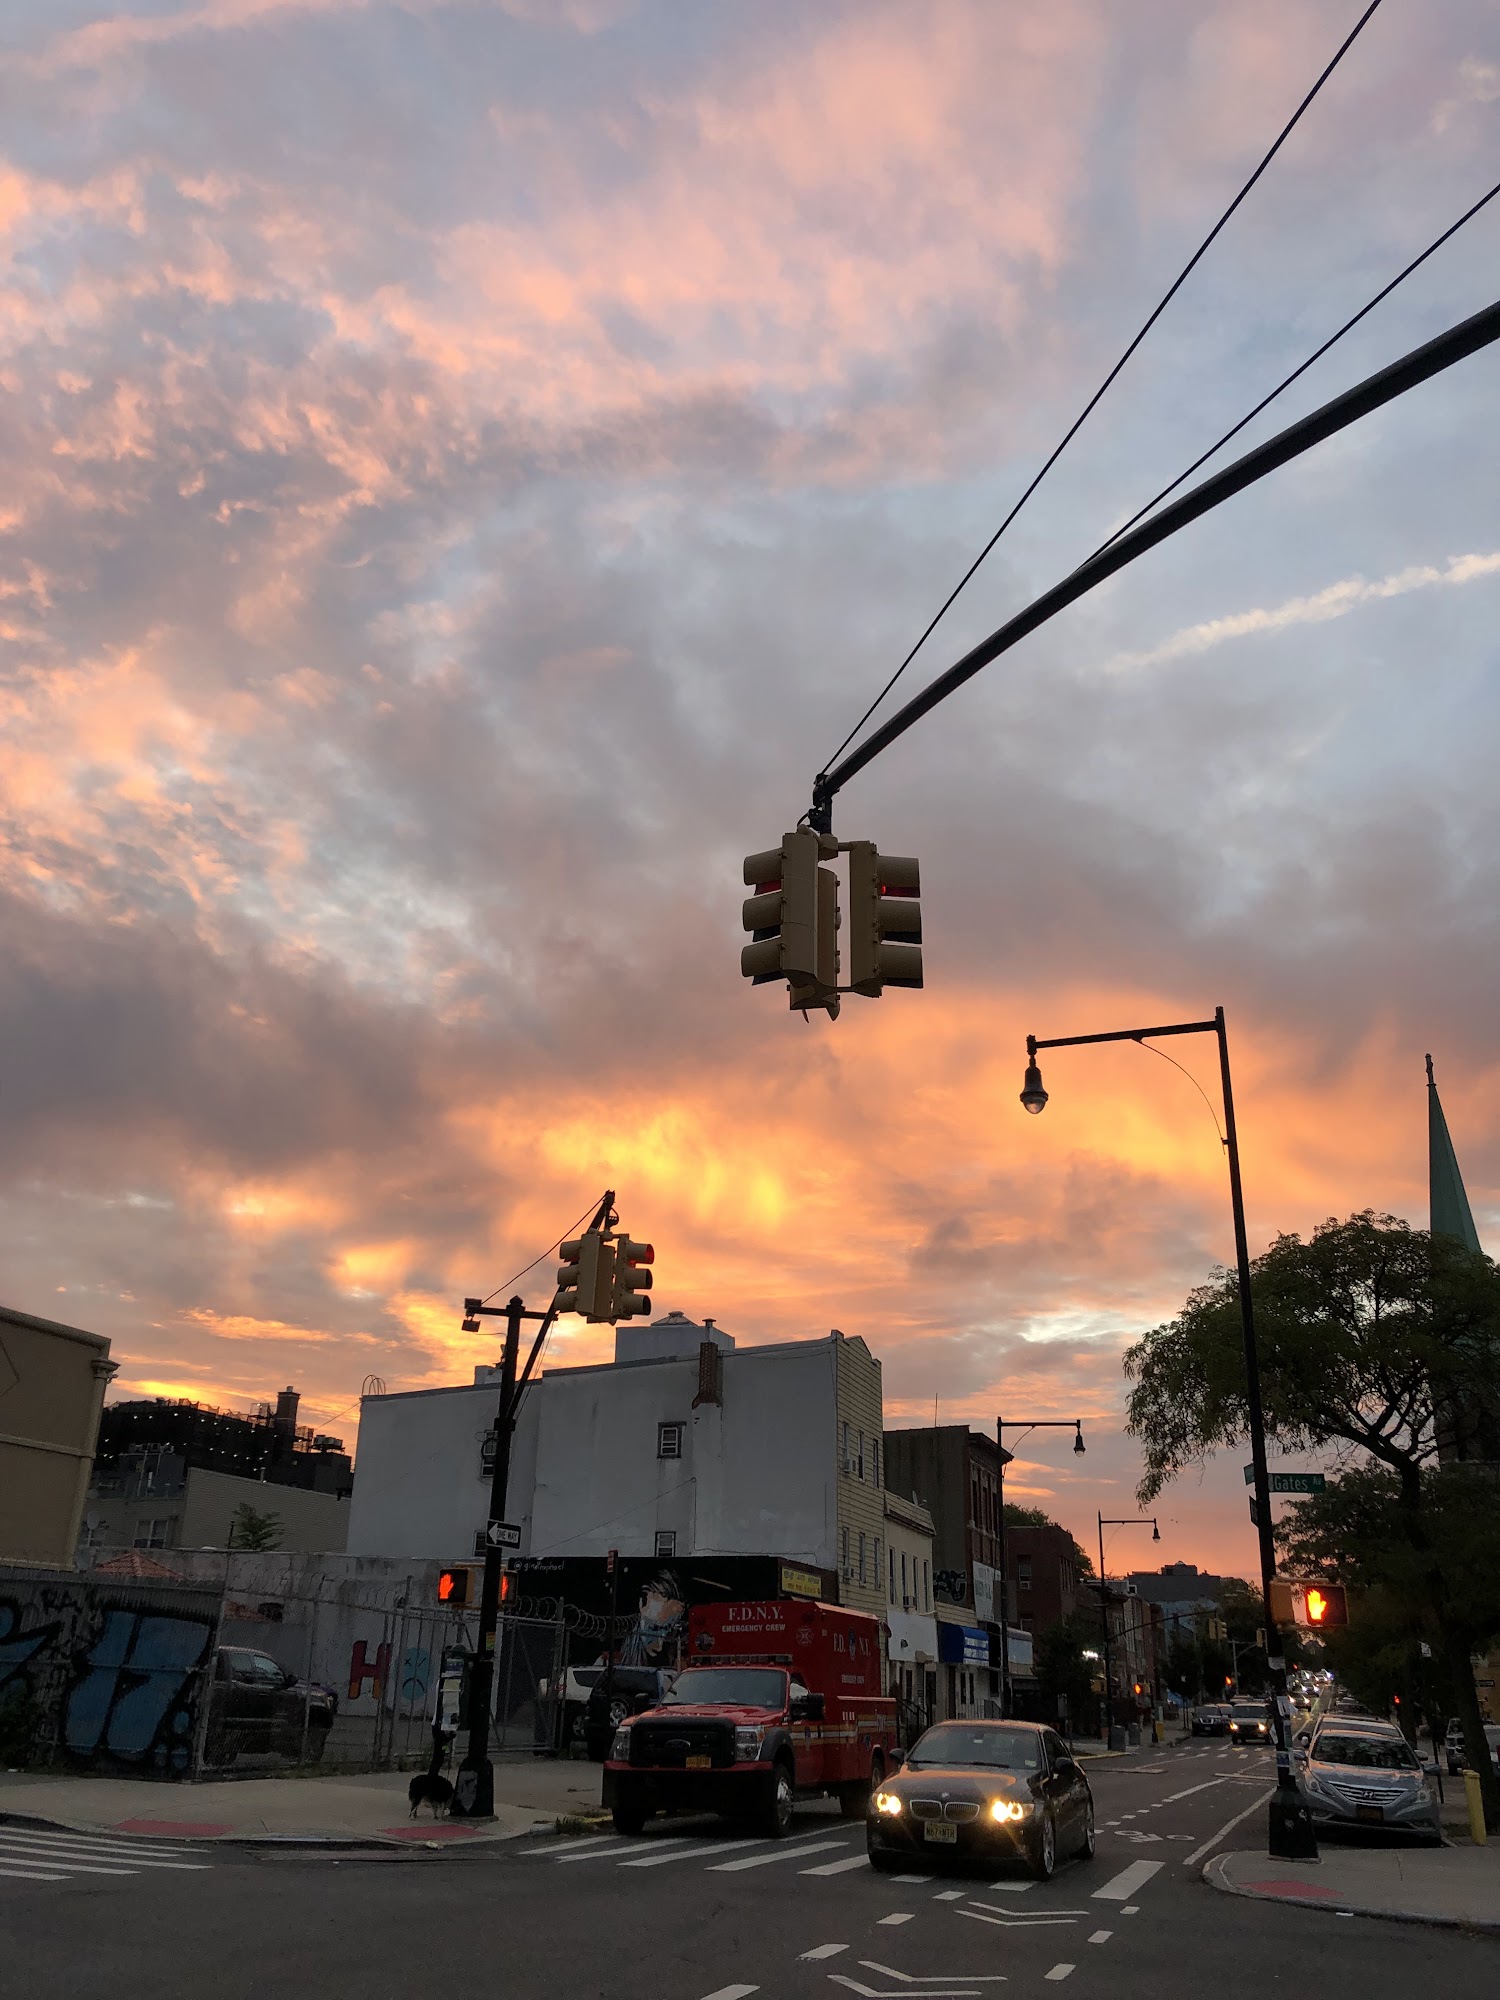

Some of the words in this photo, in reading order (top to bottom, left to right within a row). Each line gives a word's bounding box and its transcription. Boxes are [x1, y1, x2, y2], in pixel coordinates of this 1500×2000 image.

[1274, 1475, 1308, 1491] Gates
[1312, 1477, 1321, 1486] Av
[496, 1529, 506, 1540] ONE
[507, 1531, 518, 1542] WAY
[728, 1606, 783, 1620] F.D.N.Y.
